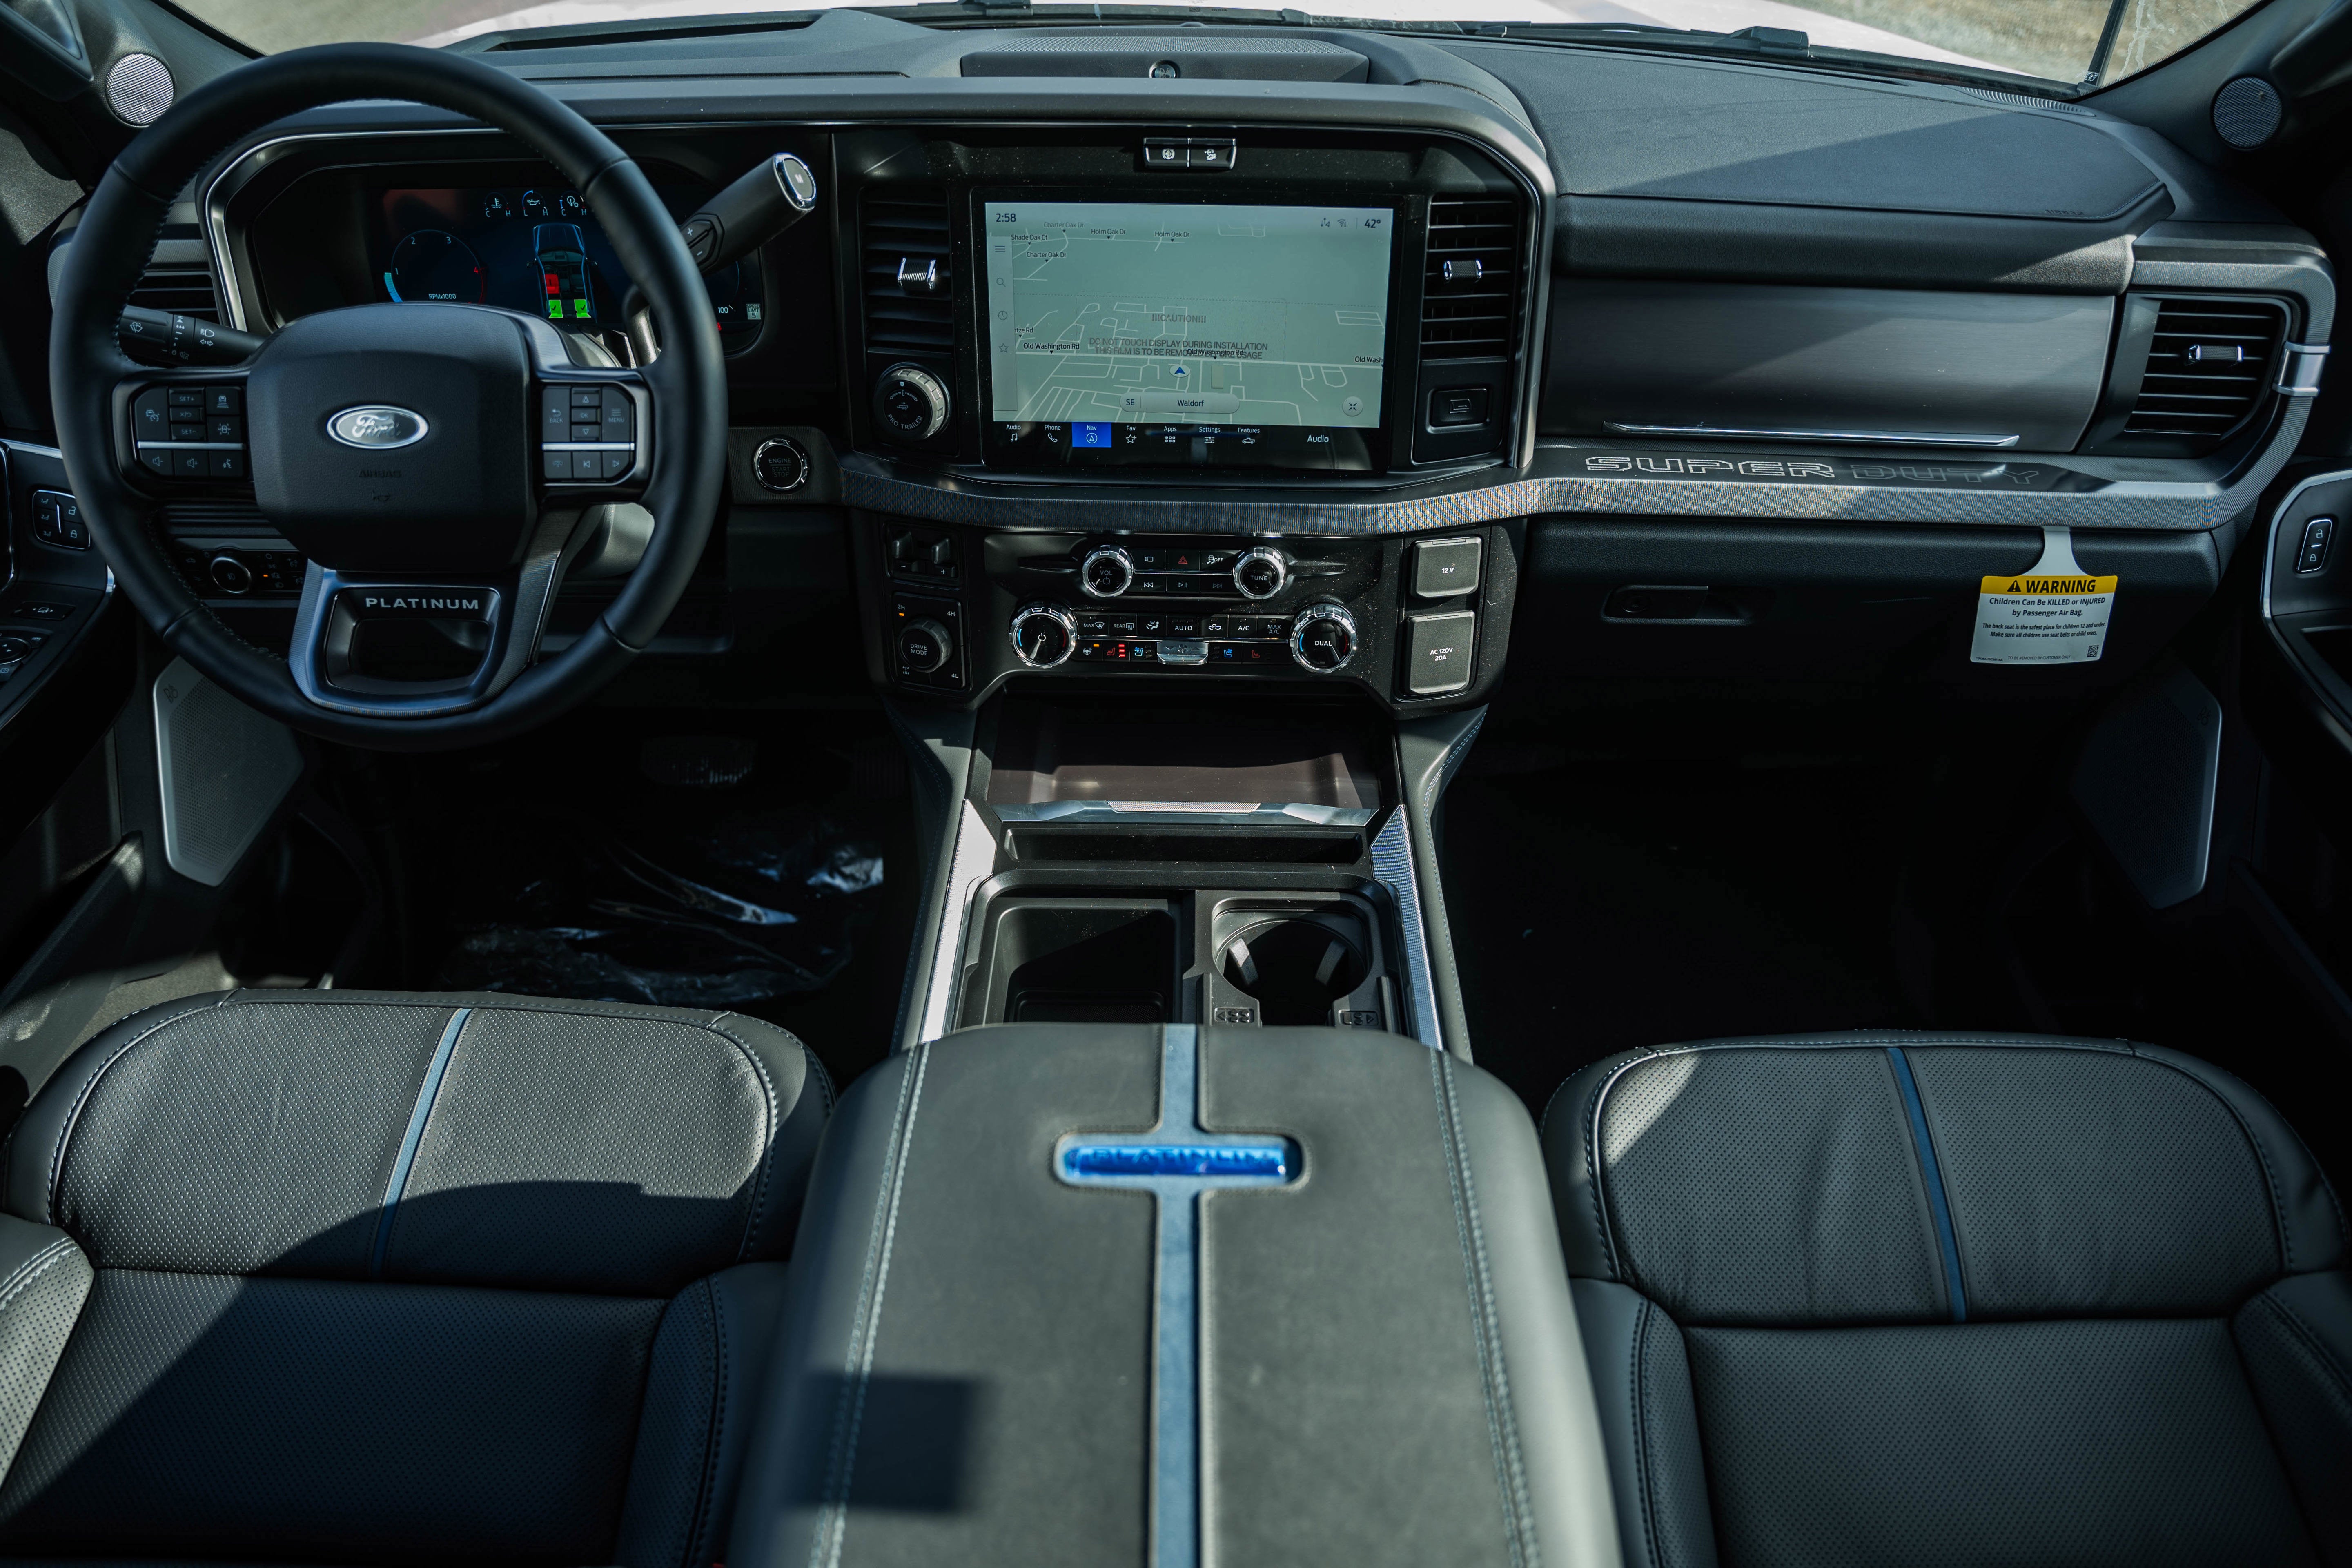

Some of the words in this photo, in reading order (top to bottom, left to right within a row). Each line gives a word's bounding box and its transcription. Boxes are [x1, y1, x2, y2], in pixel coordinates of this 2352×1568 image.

[996, 213, 1016, 223] 2:58
[1364, 219, 1381, 228] 42°
[1102, 338, 1119, 346] NOT
[1121, 339, 1147, 347] TOUCH
[1149, 339, 1181, 347] DISPLAY
[1183, 340, 1212, 349] DURING
[1214, 341, 1267, 350] INSTALLATION
[1095, 346, 1112, 355] THIS
[887, 414, 899, 426] PRO
[901, 415, 923, 430] TRAILER
[1585, 456, 1836, 478] SUPER
[1850, 464, 2040, 484] DUTY
[2026, 579, 2096, 593] WARNING
[365, 597, 479, 610] PLATINUM
[2080, 597, 2105, 606] INJURED
